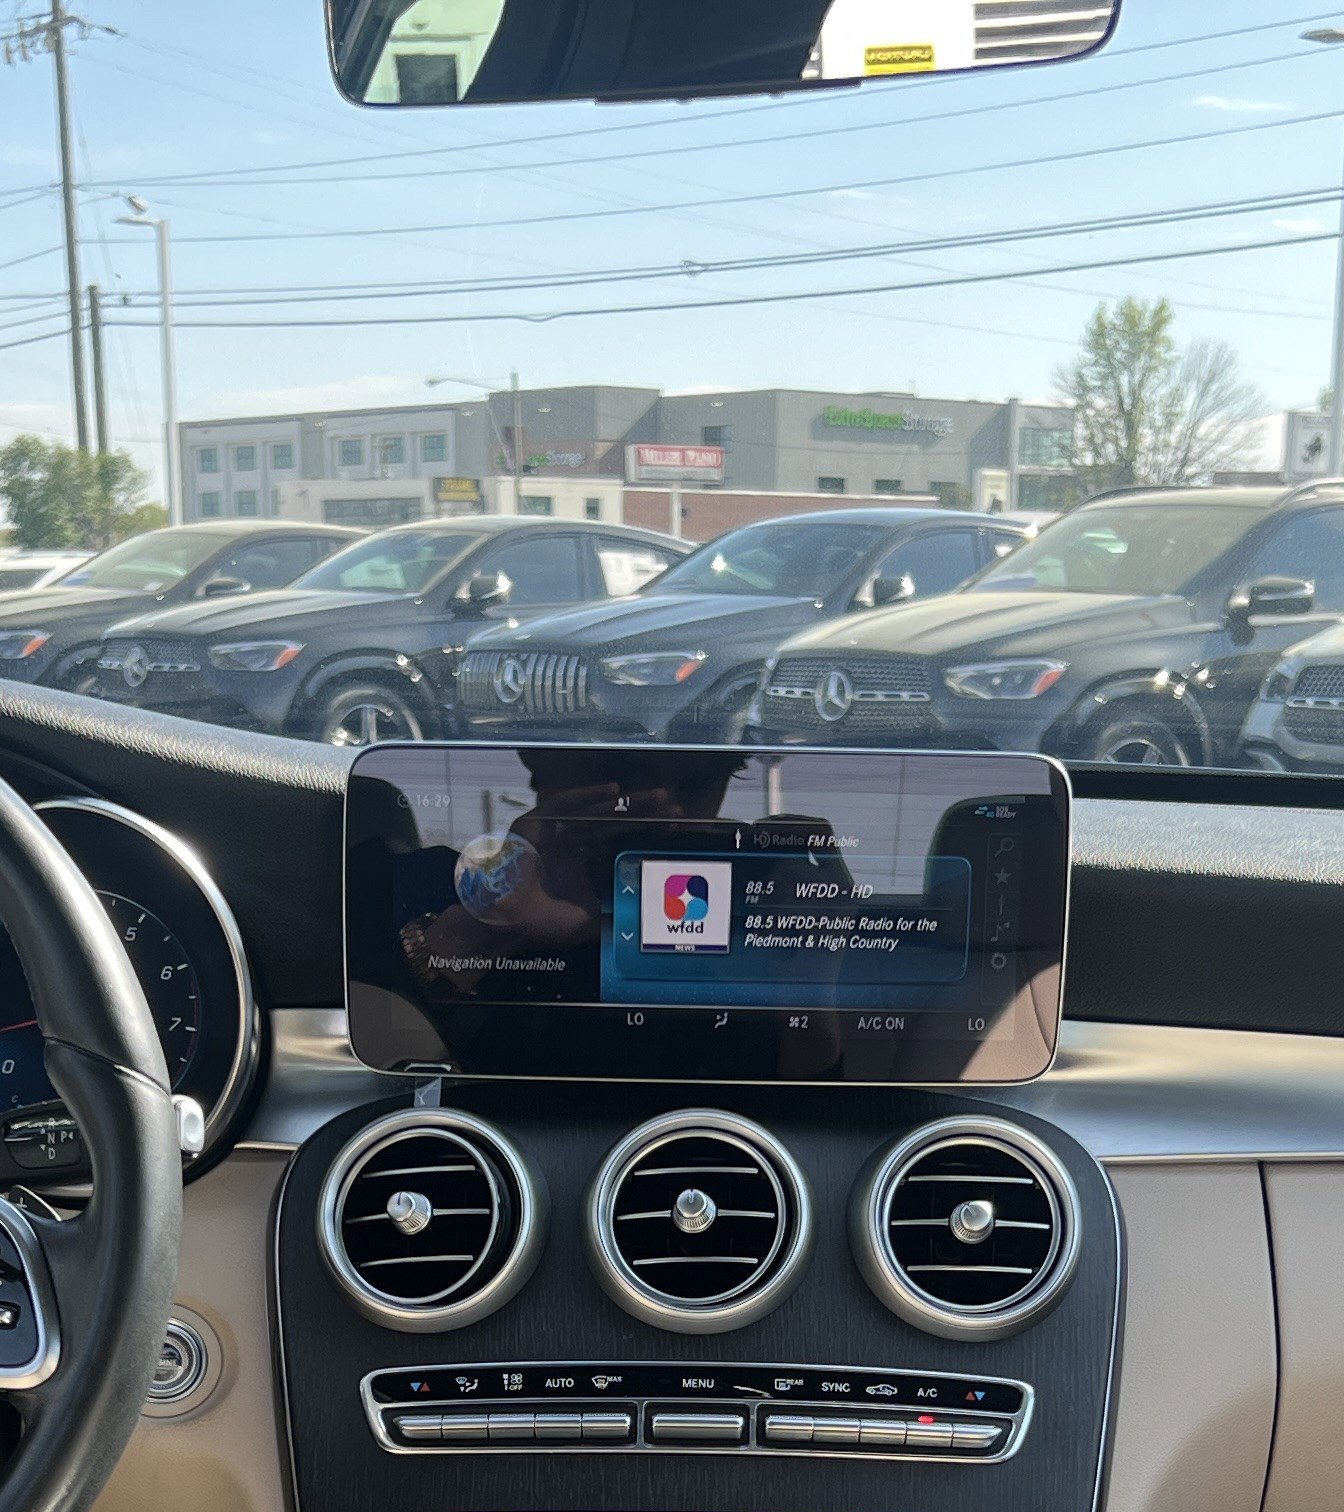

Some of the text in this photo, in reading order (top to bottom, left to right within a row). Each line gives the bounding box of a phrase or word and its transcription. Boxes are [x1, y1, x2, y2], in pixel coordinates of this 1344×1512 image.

[417, 795, 450, 808] 16:29
[773, 834, 804, 846] Radio
[807, 835, 825, 847] FM
[827, 835, 860, 848] Public
[745, 881, 774, 895] 88.5
[796, 883, 838, 899] WFDD
[850, 883, 873, 900] HD
[745, 896, 759, 904] FM
[667, 921, 704, 935] wfdd
[745, 915, 937, 932] 88.5 WFDD-Public Radio for the
[124, 927, 137, 941] 5
[744, 933, 899, 952] Piedmont & High Country
[428, 955, 566, 972] Navigation Unavailable
[160, 966, 173, 980] 6
[169, 1017, 182, 1031] 7
[627, 1012, 644, 1026] LO
[800, 1016, 809, 1029] 2
[857, 1017, 905, 1030] A/C ON
[968, 1018, 985, 1031] LO
[2, 1060, 15, 1074] 0
[47, 1131, 68, 1144] N P
[48, 1148, 56, 1160] D
[545, 1378, 574, 1388] AUTO
[682, 1378, 714, 1389] MENU
[786, 1378, 803, 1386] REAR
[821, 1381, 850, 1393] SYNC
[917, 1388, 937, 1397] A/C
